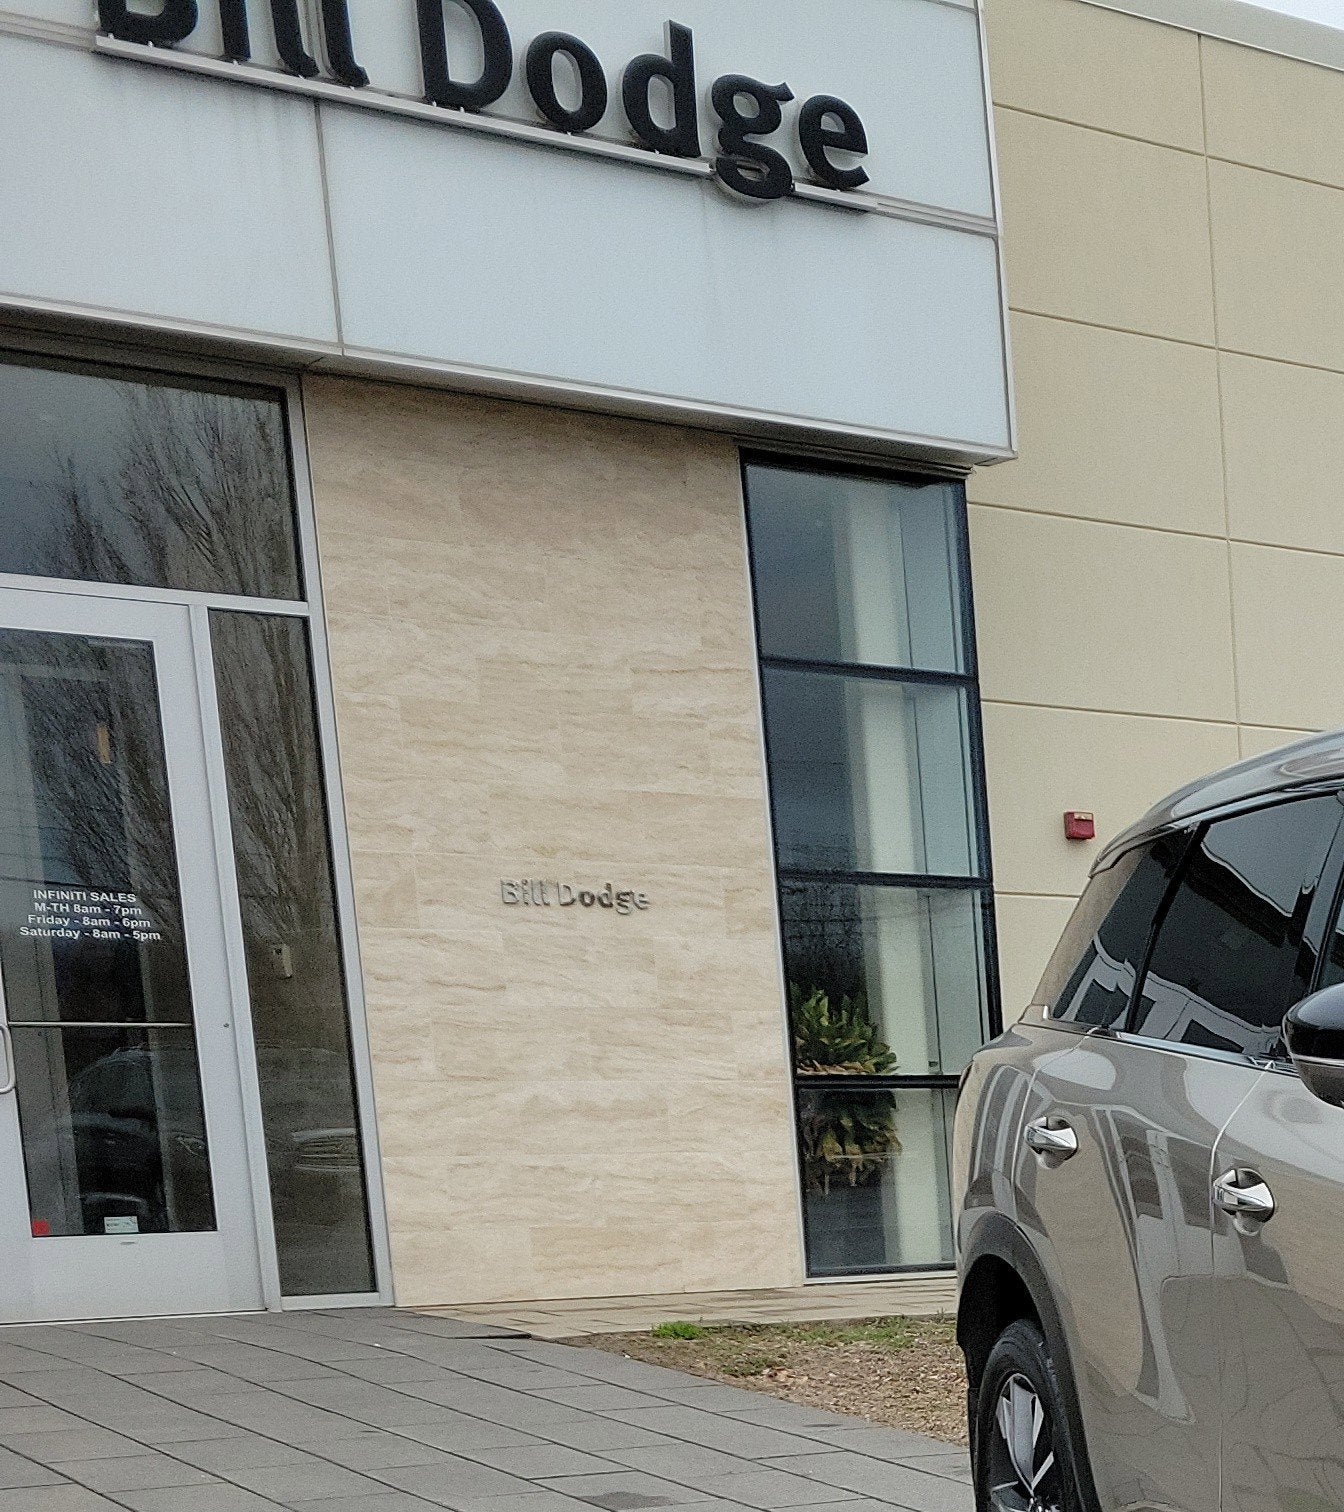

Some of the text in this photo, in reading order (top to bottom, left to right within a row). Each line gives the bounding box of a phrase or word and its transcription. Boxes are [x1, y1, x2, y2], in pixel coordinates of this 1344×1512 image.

[417, 0, 870, 199] Dodge
[33, 889, 137, 903] INFINITI SALES
[501, 879, 650, 915] Bill Dodge
[34, 902, 70, 913] M-TH
[73, 903, 102, 914] 8am
[113, 905, 142, 916] 7pm
[28, 914, 71, 927] Friday
[82, 916, 111, 926] 8am
[122, 917, 151, 929] 6pm
[20, 926, 81, 940] Saturday
[92, 929, 121, 939] 8am
[132, 930, 161, 942] 5pm
